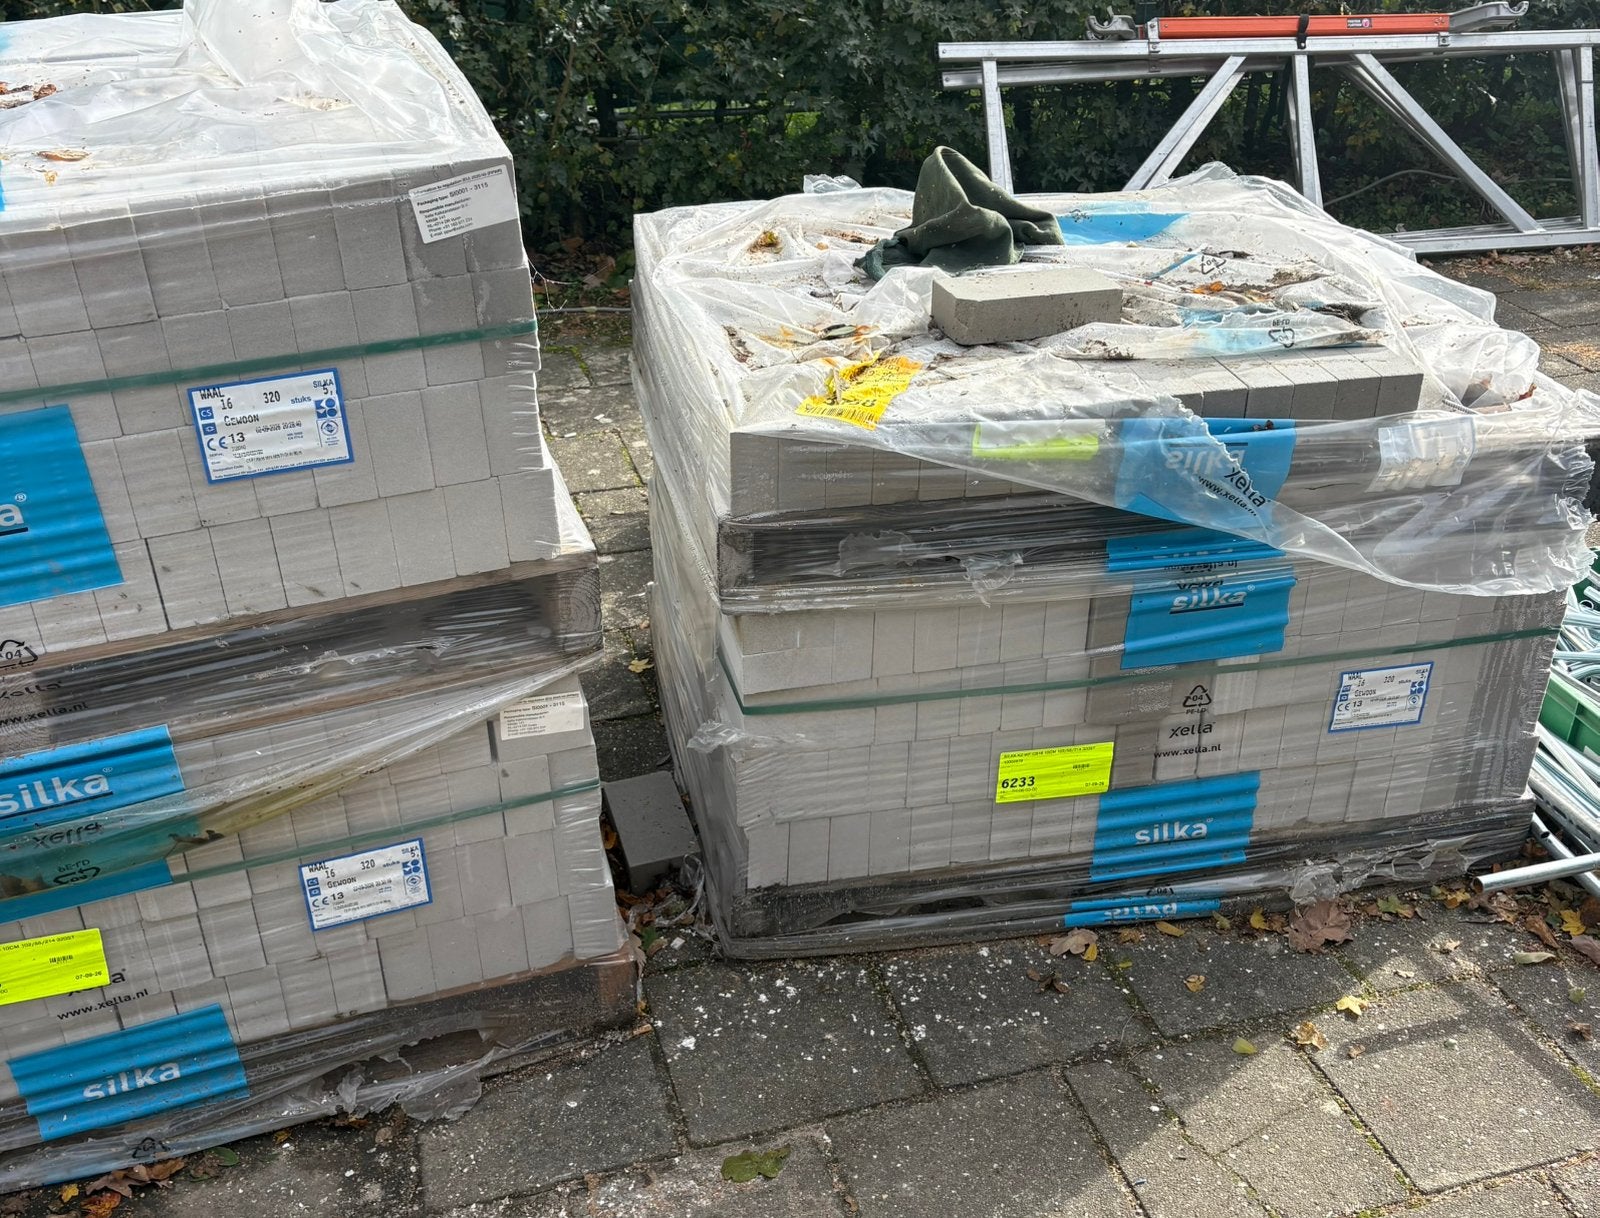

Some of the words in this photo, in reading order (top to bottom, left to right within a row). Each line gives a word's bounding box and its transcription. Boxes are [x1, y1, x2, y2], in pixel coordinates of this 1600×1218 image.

[473, 182, 488, 190] 3115
[313, 379, 334, 389] SILKA
[199, 387, 225, 400] WAAL
[221, 398, 233, 410] 16
[263, 391, 281, 404] 320
[290, 396, 312, 405] stuks
[228, 432, 246, 444] 13
[6, 649, 23, 660] 04
[1352, 700, 1363, 708] 13
[1154, 744, 1222, 759] www.xella.nl
[1001, 775, 1036, 789] 6233
[308, 861, 329, 873] WAAL
[325, 869, 336, 879] 16
[360, 859, 376, 870] 320
[326, 877, 357, 889] GEWOON
[330, 892, 345, 901] 13
[57, 988, 149, 1020] www.xella.nl
[83, 1062, 181, 1099] silka
